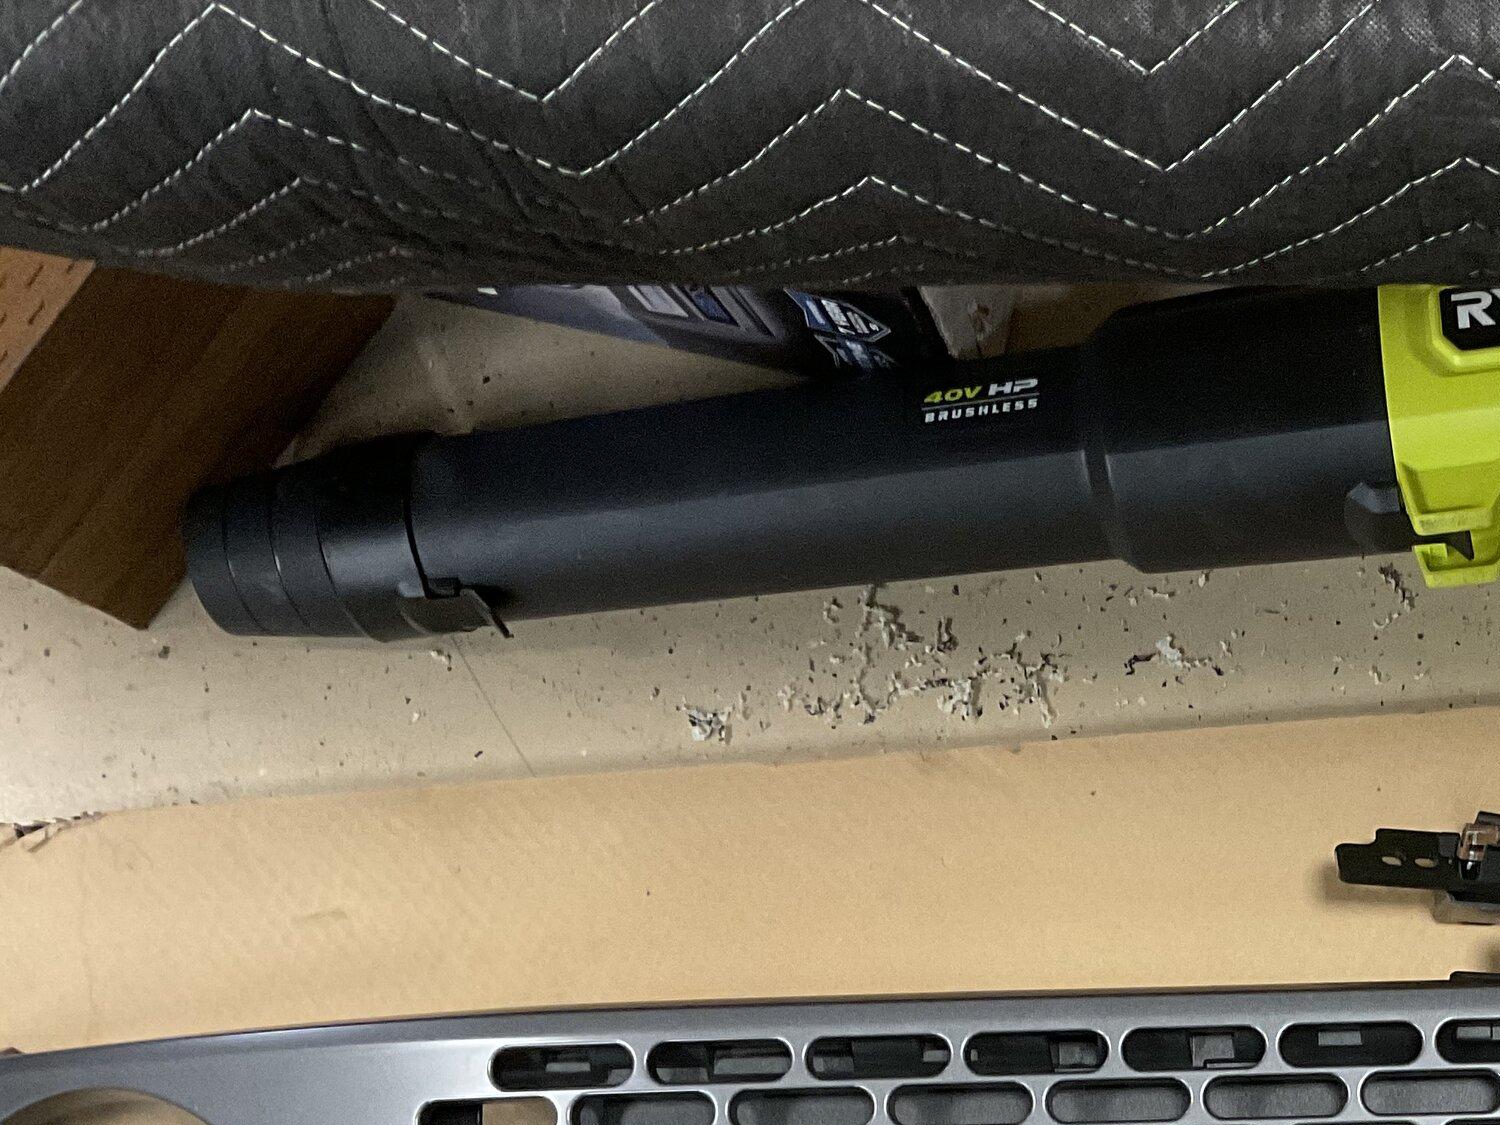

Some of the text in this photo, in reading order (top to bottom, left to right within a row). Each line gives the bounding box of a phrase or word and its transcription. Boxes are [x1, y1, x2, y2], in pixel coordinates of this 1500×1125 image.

[923, 378, 1038, 403] 40V HP
[924, 398, 1038, 423] BRUSHLESS
